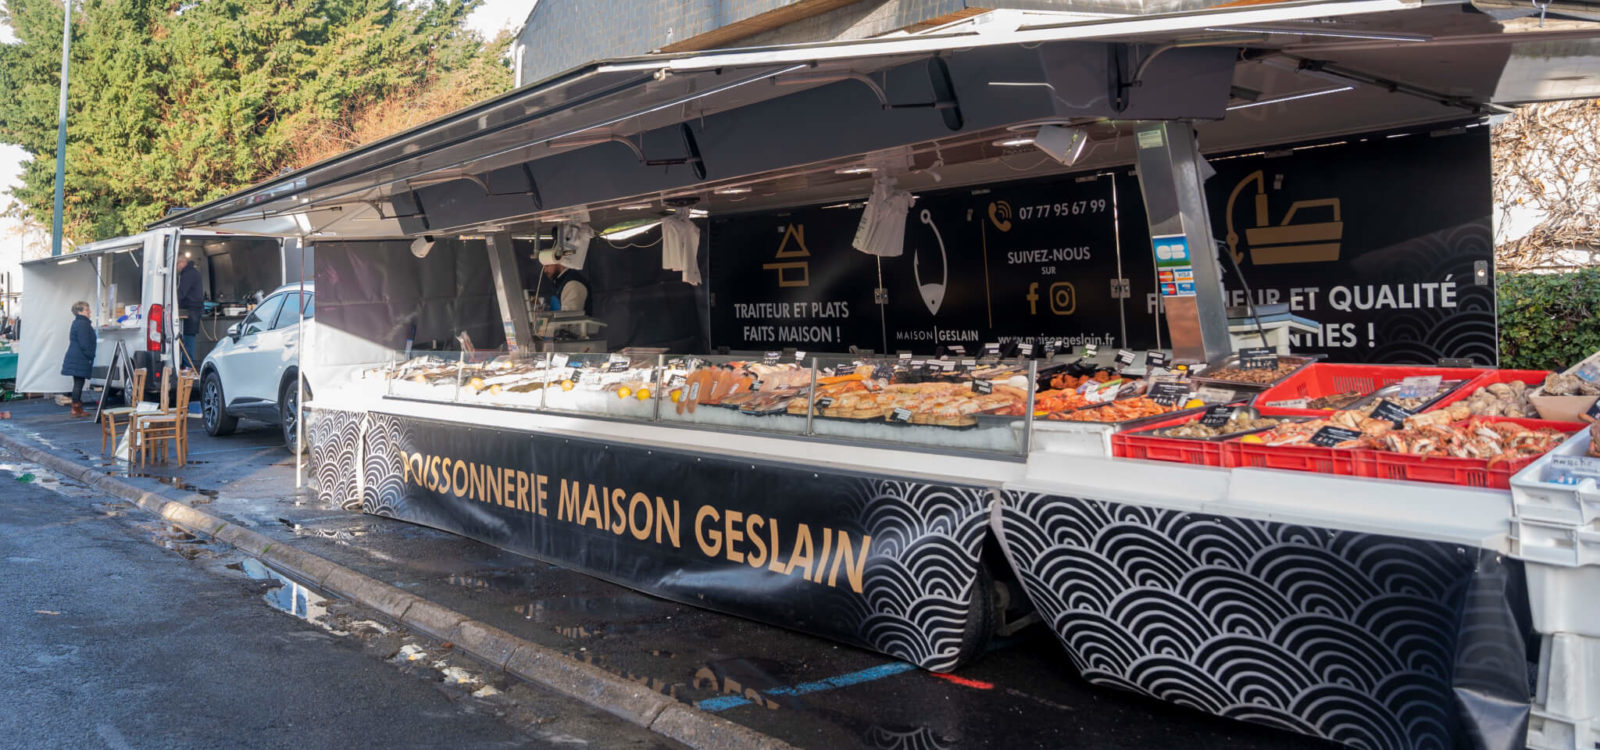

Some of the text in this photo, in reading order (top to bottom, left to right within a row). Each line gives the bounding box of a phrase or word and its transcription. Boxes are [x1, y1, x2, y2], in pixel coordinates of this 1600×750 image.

[1019, 198, 1106, 220] 07 77 95 67 99
[1007, 246, 1091, 264] SUIVEZ-NOUS
[1041, 266, 1057, 275] SUR
[1290, 287, 1320, 311] ET
[1328, 274, 1457, 312] QUALITÉ
[734, 301, 850, 318] TRAITEUR ET PLATS
[743, 326, 841, 342] FAITS MAISON !
[896, 330, 979, 341] MAISON GESLAIN
[557, 478, 681, 549] MAISON
[694, 504, 872, 594] GESLAIN
